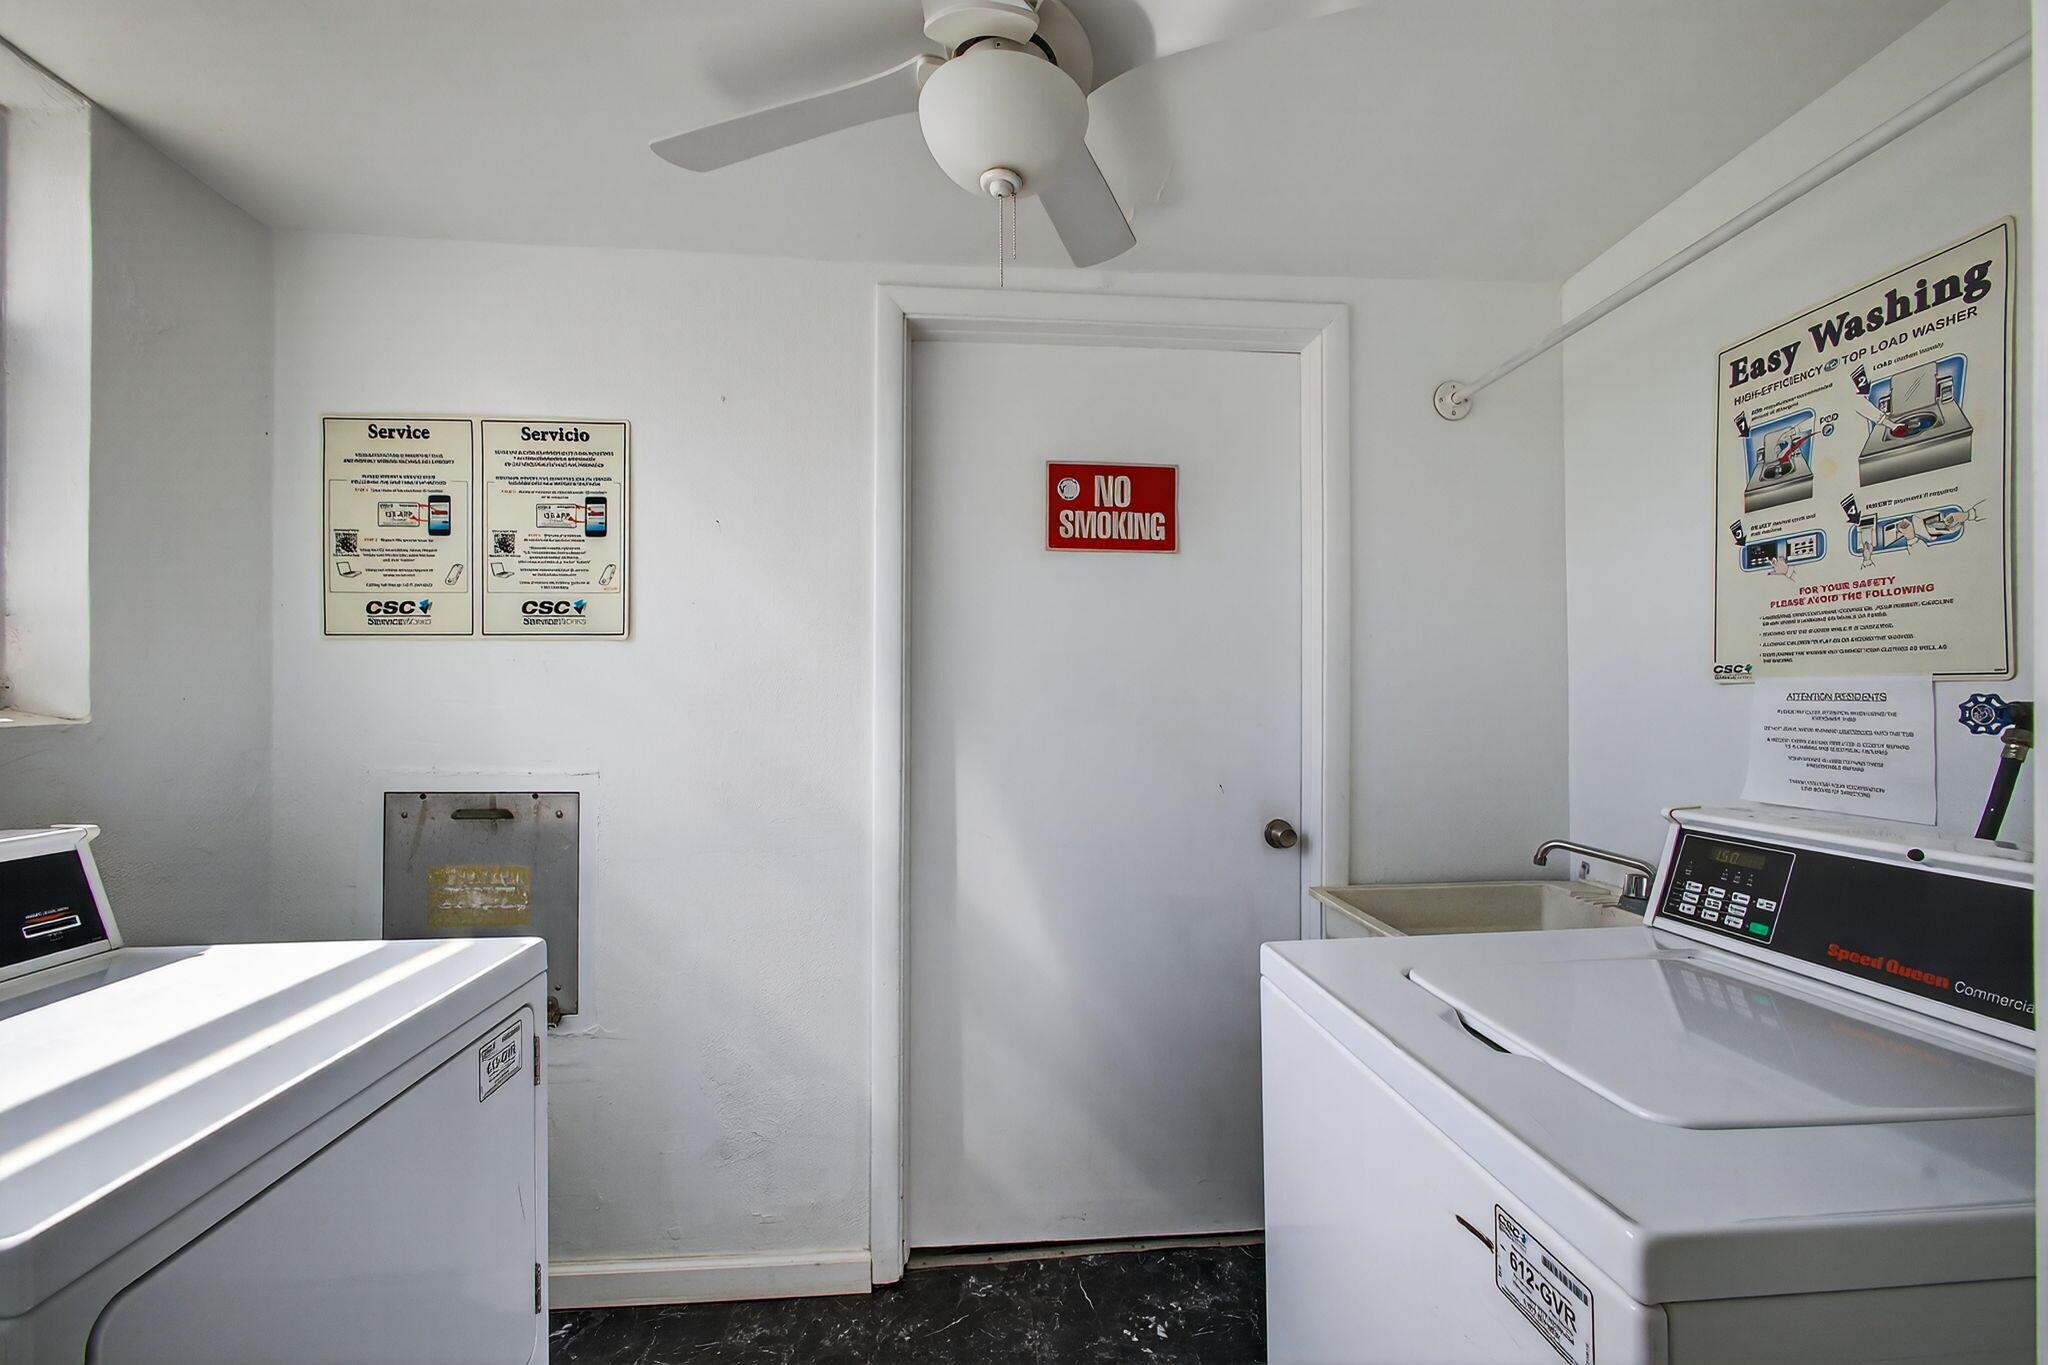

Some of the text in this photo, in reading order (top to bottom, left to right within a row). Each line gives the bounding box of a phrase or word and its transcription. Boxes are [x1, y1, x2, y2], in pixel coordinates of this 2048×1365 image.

[1729, 260, 1992, 389] Easy Washing
[1734, 364, 1823, 406] HIGH-EFFICIENCY
[1842, 348, 1867, 364] TOP
[1871, 332, 1908, 354] LOAD
[1912, 306, 1979, 338] WASHER
[1858, 376, 1867, 388] 2
[368, 424, 430, 439] Service
[521, 427, 590, 442] Servicio
[1094, 475, 1131, 508] NO
[1059, 509, 1165, 541] SMOKING
[1799, 576, 1896, 595] FOR YOUR SAFETY
[1770, 583, 1934, 609] PLEASE AVOID THE FOLLOWING
[366, 601, 416, 614] CSC
[522, 601, 570, 614] CSC
[1713, 665, 1744, 673] CSC
[1786, 692, 1833, 701] ATTENTION
[1827, 943, 1883, 971] Speed
[1886, 959, 1949, 989] Queen
[1509, 1251, 1577, 1334] 612-GVR
